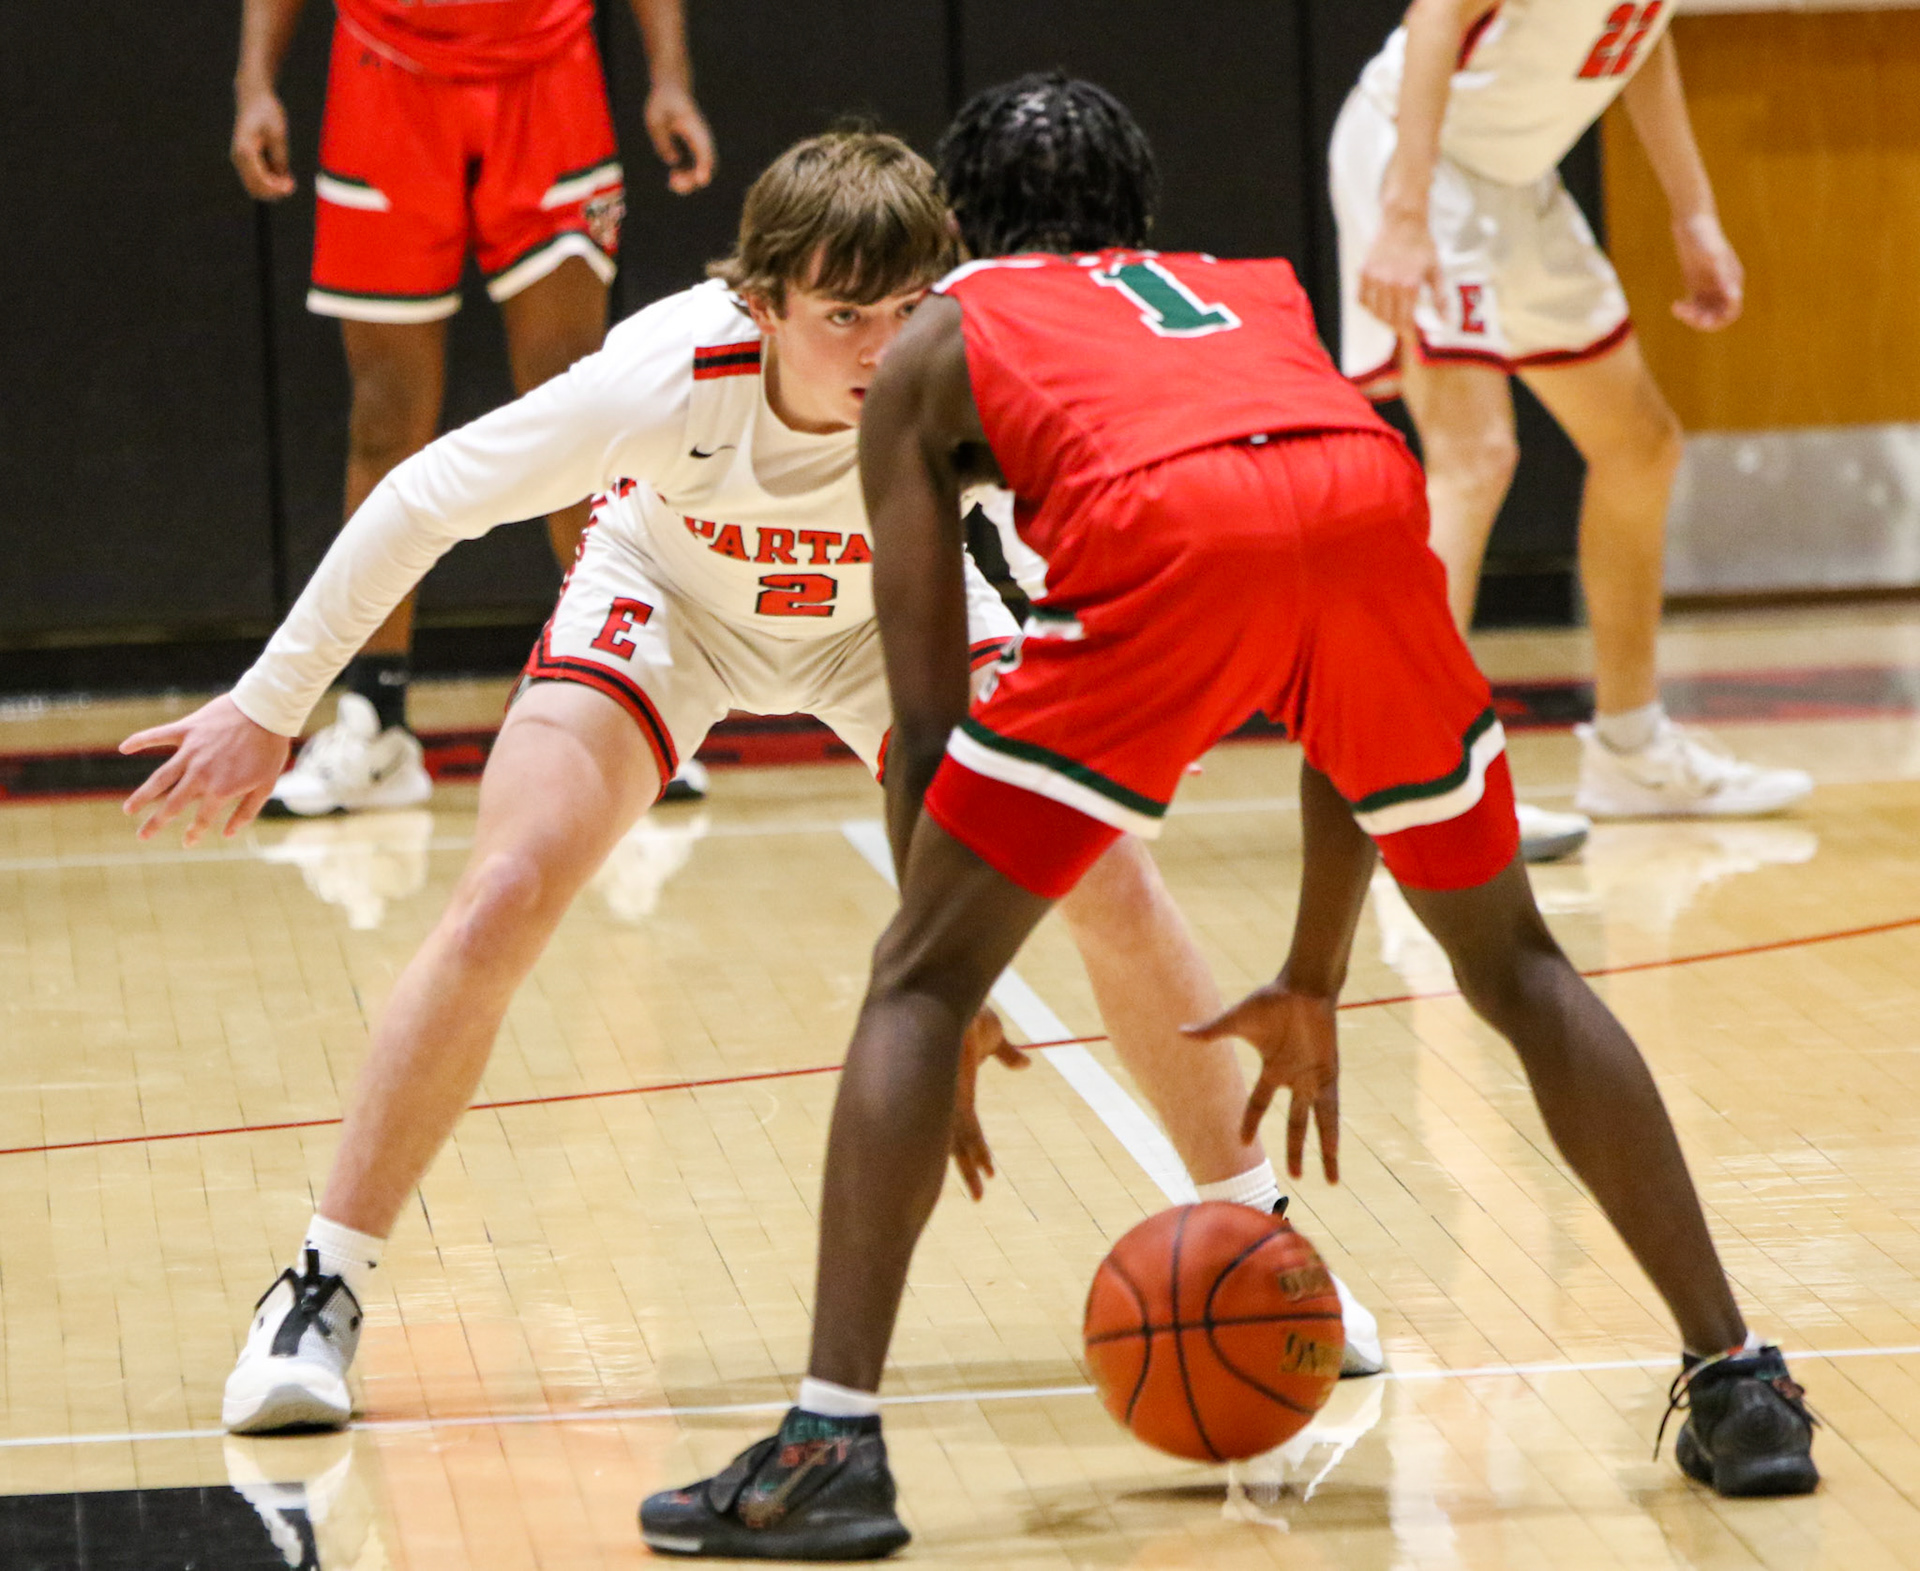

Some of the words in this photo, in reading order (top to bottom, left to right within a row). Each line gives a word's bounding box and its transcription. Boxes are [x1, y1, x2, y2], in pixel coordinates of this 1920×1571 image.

[1089, 258, 1243, 339] 1
[1457, 284, 1485, 334] E
[755, 573, 838, 617] 2
[589, 596, 654, 662] E
